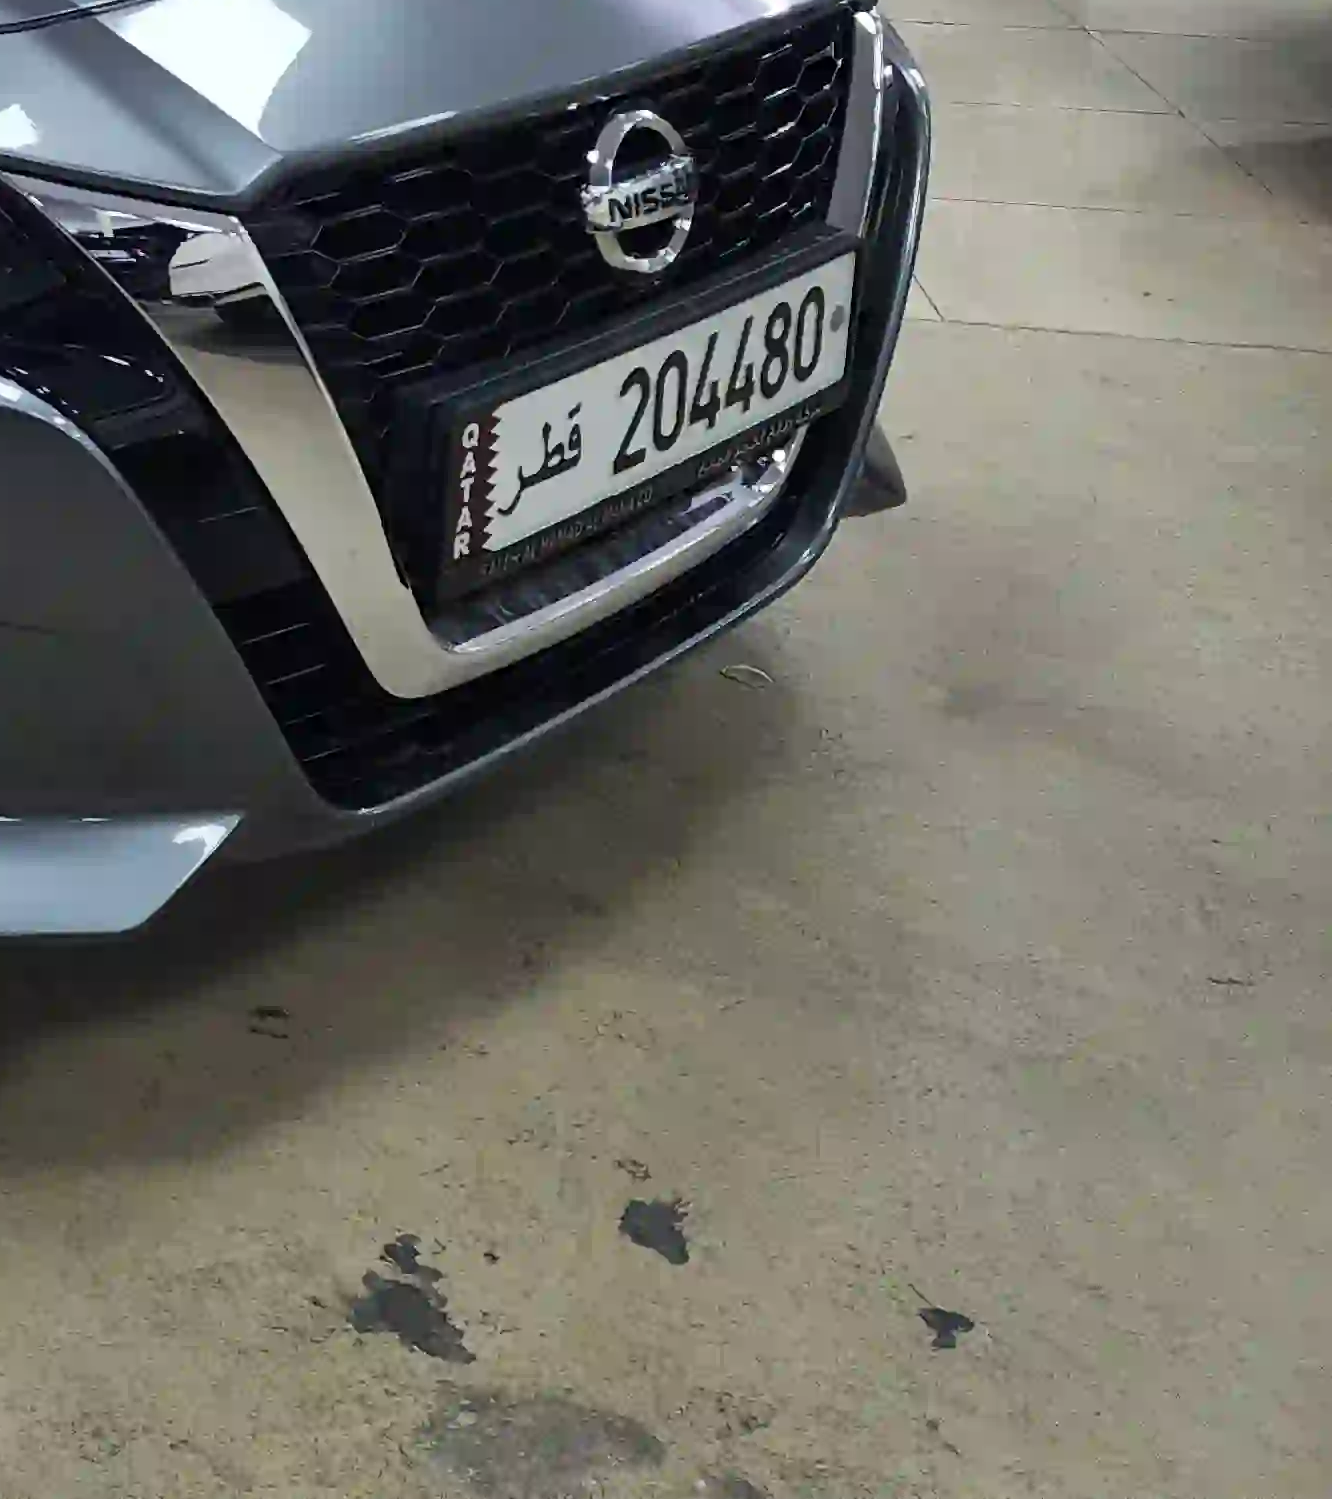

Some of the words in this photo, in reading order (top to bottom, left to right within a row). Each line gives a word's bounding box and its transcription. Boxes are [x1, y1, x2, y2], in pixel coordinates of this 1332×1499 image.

[612, 285, 825, 475] 204480
[452, 422, 481, 561] QATAR
[497, 403, 583, 517] قطر
